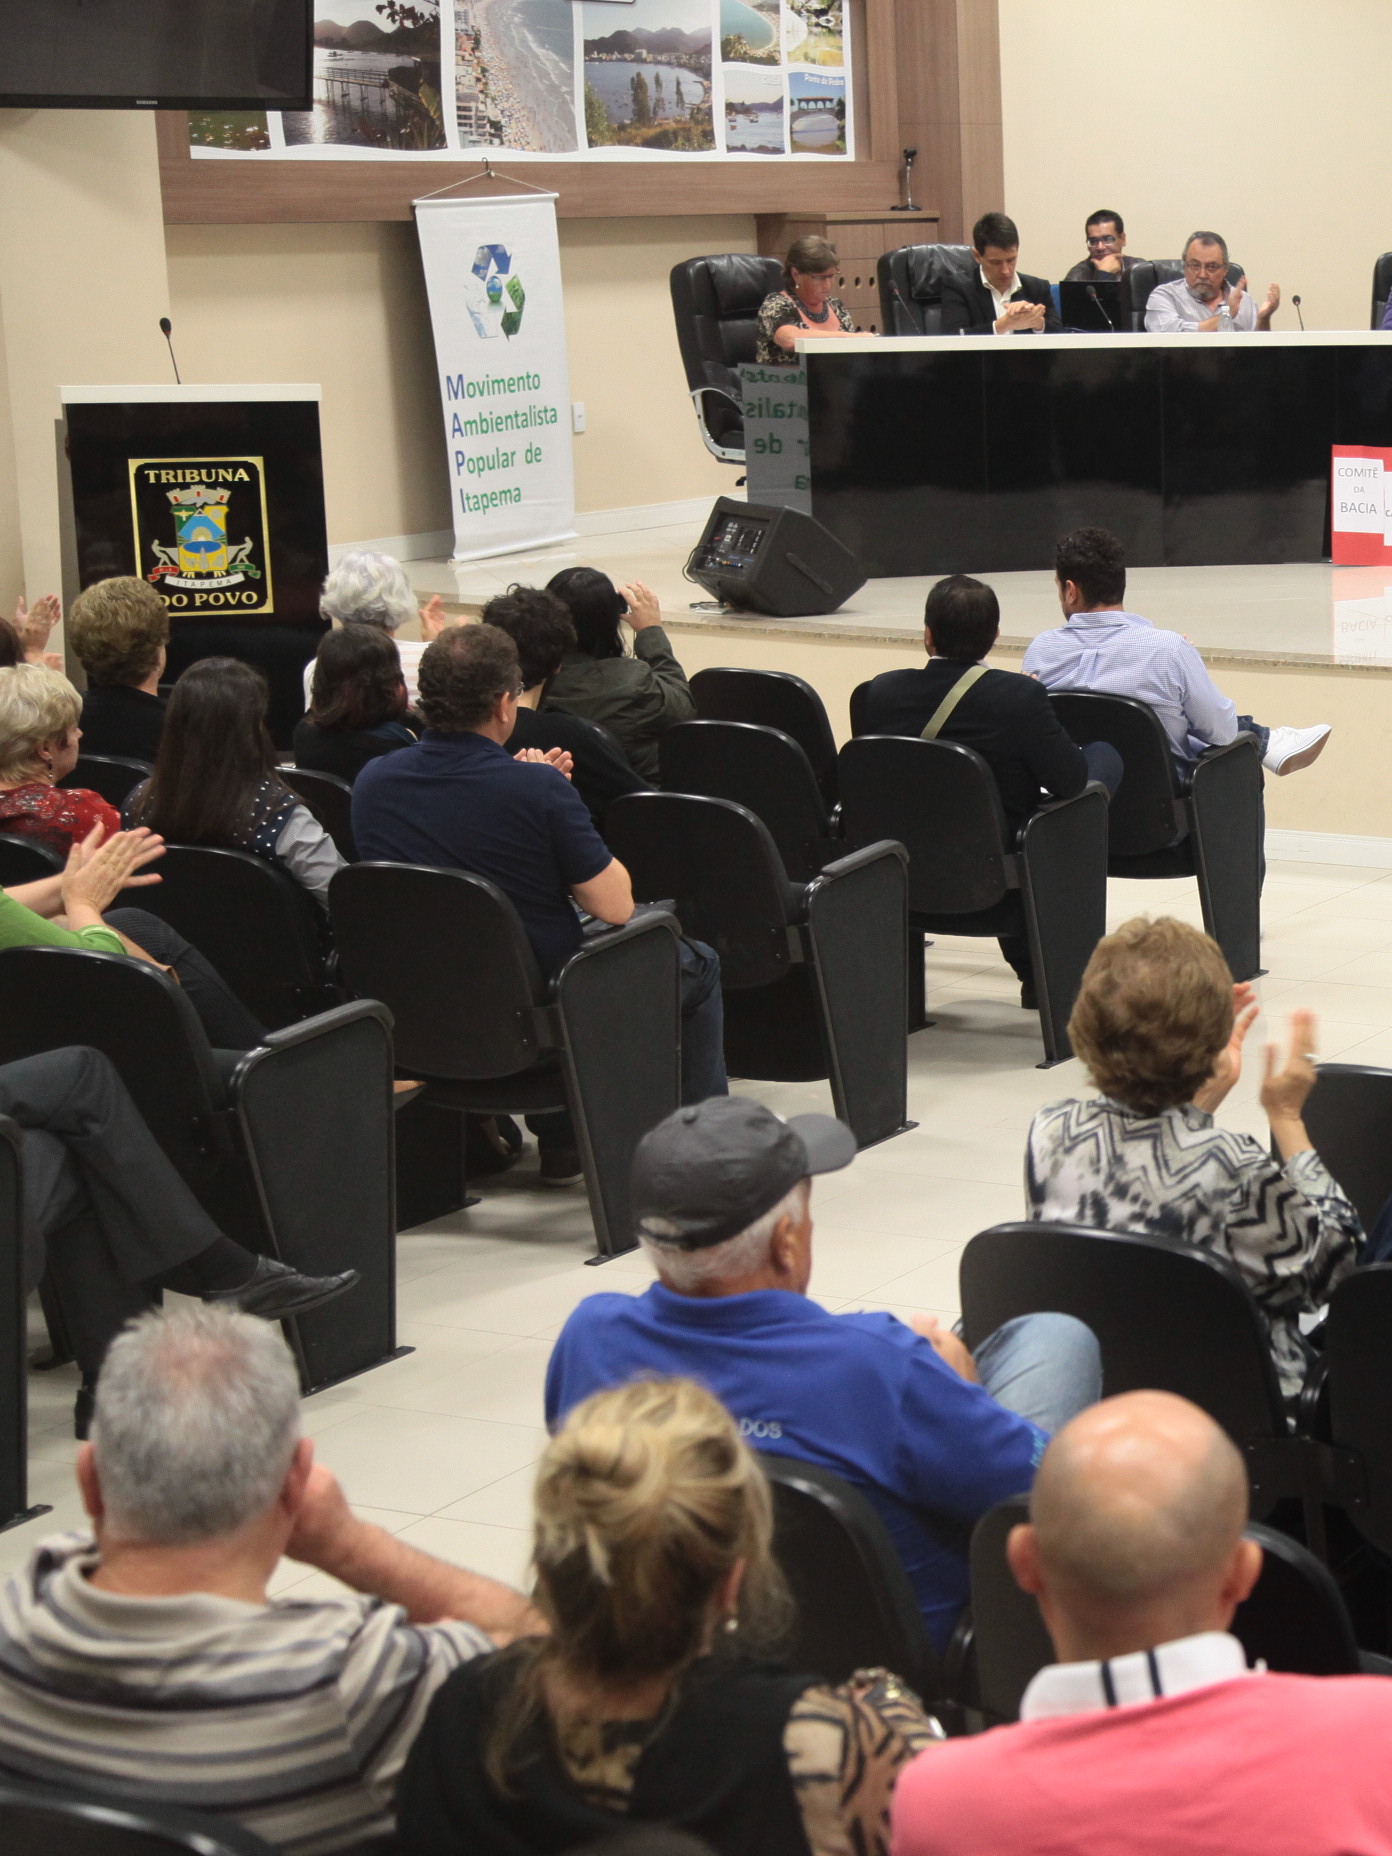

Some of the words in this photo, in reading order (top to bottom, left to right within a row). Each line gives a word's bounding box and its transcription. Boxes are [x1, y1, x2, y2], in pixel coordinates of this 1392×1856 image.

[446, 371, 541, 401] Movimento
[451, 404, 558, 439] Ambientalista
[455, 448, 517, 478] Popular
[525, 442, 542, 465] de
[144, 467, 250, 484] TRIBUNA
[1337, 467, 1379, 478] COMITÊ
[460, 485, 522, 516] Itapema
[1340, 501, 1377, 514] BACIA
[176, 579, 233, 588] ITAPEMA
[194, 591, 258, 606] POVO
